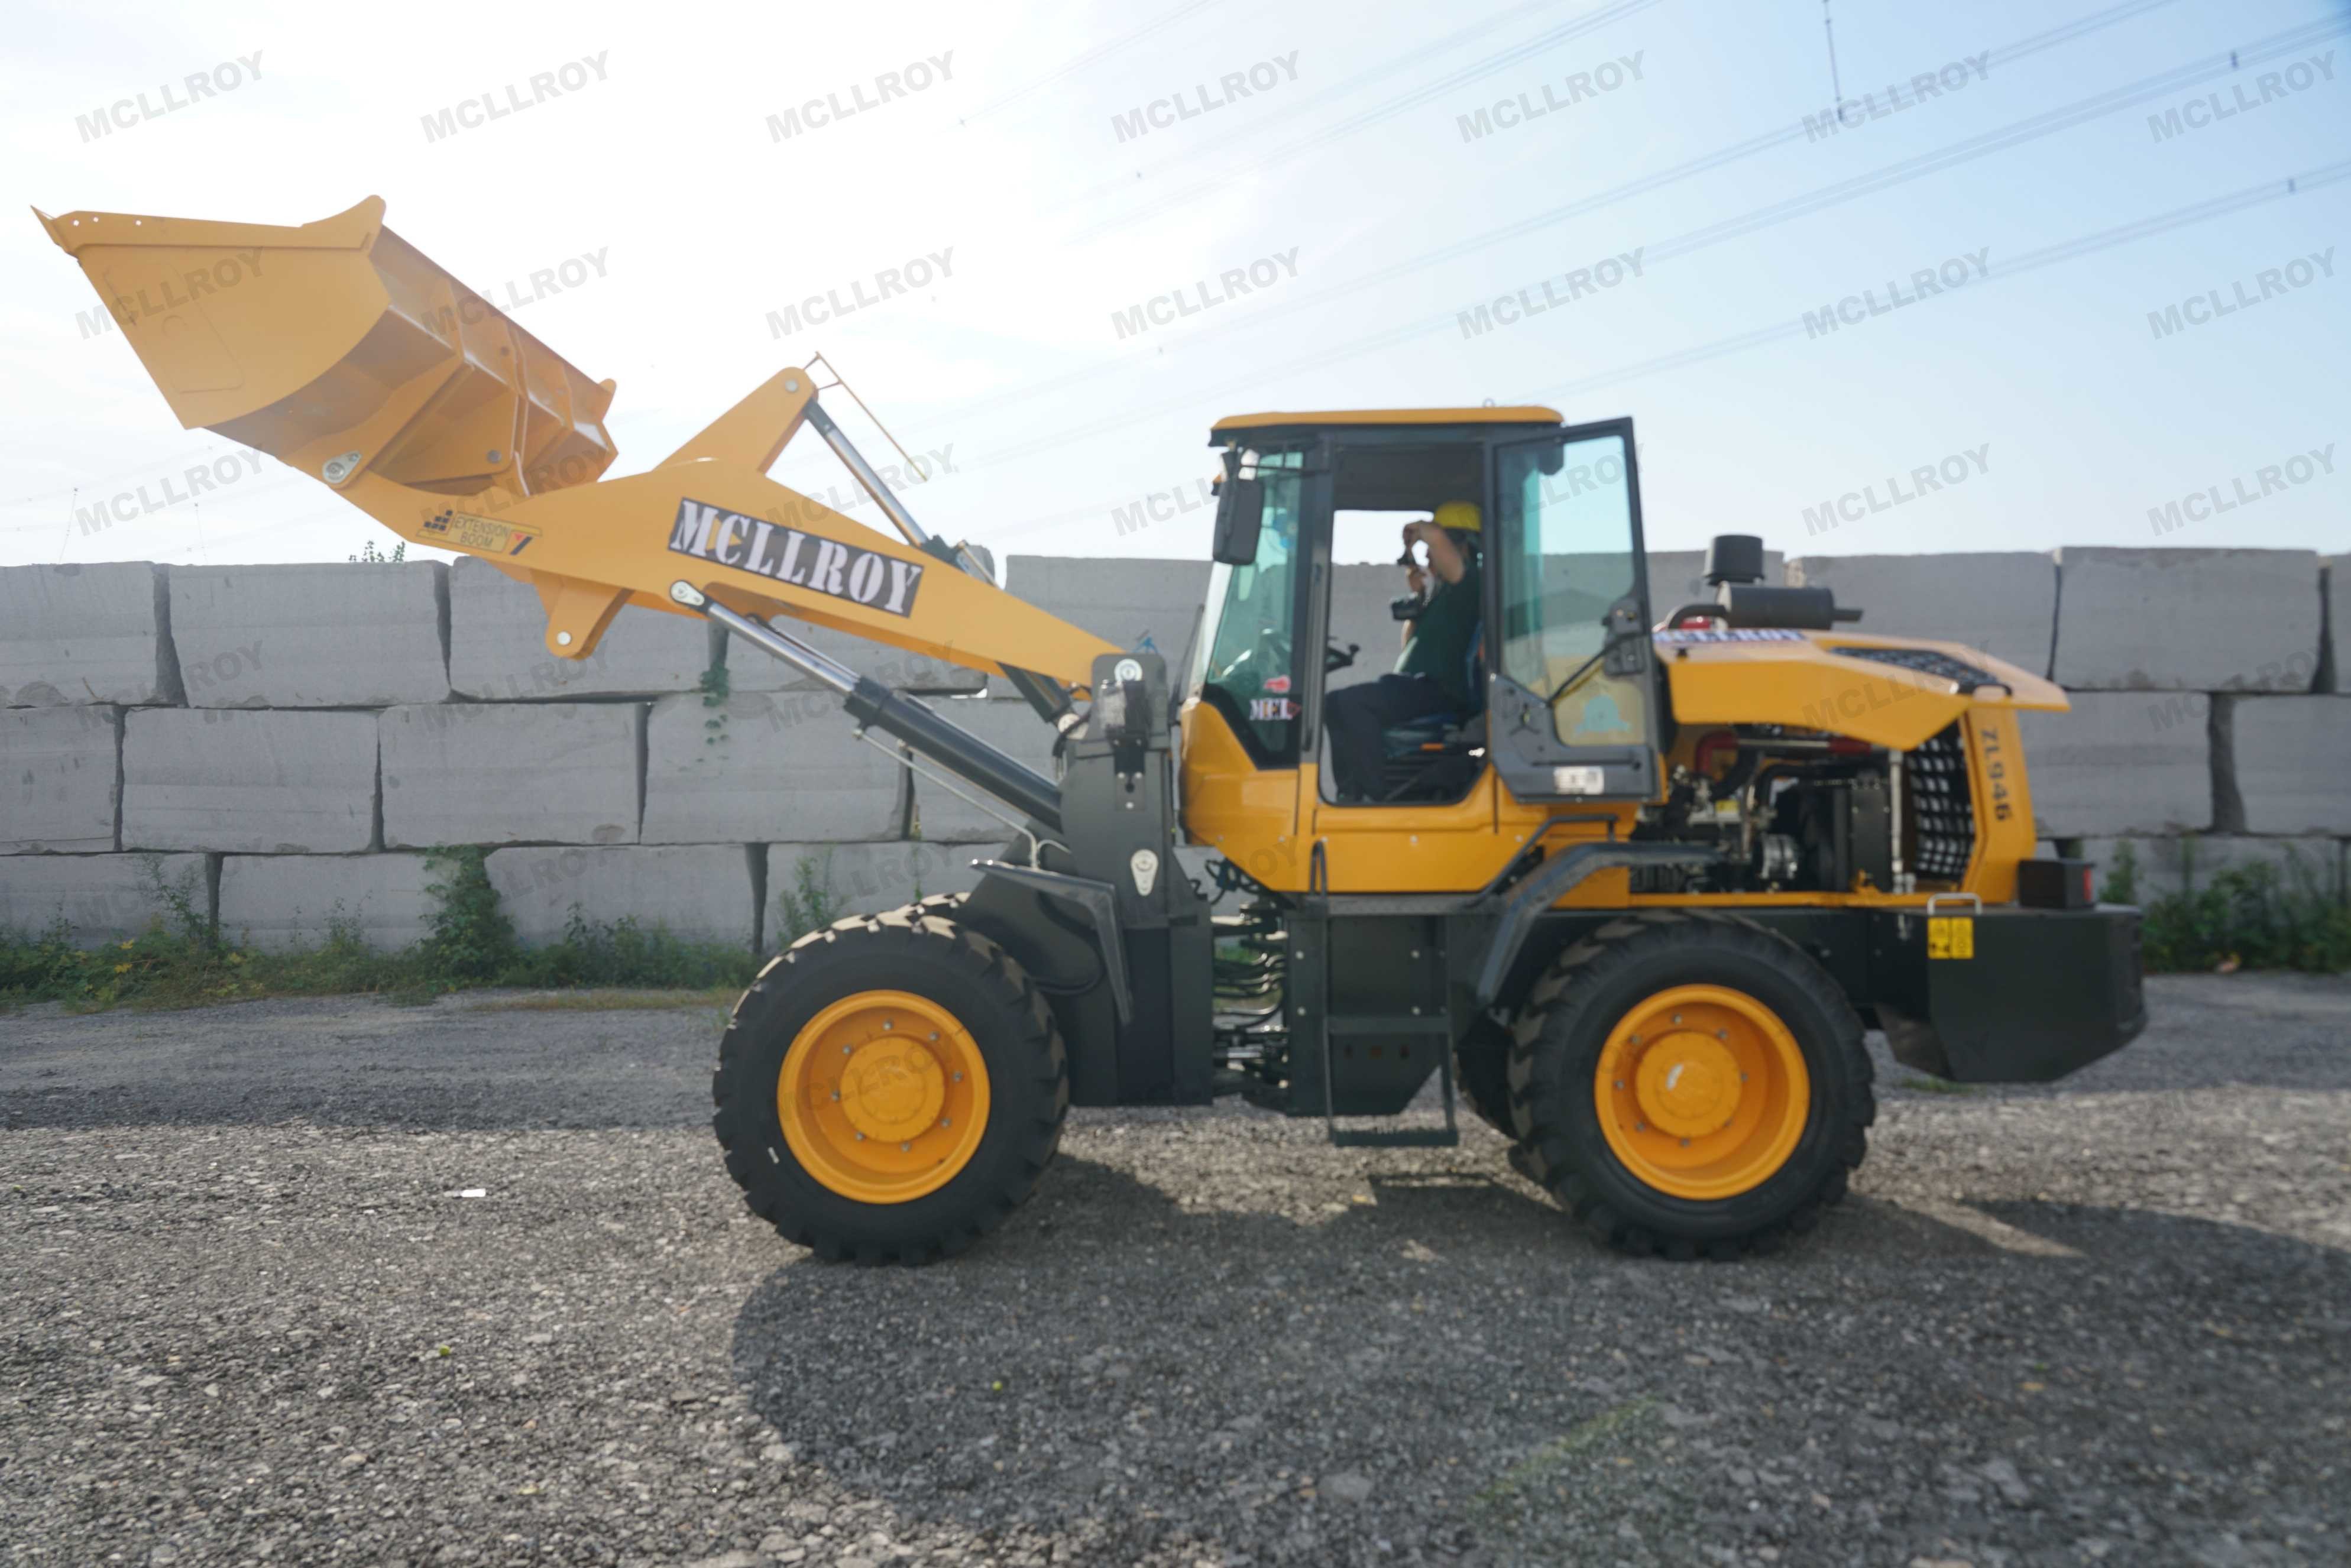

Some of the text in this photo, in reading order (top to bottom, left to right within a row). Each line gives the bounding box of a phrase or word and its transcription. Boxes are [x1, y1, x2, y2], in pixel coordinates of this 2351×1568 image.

[454, 516, 510, 537] EXTENSION
[461, 532, 493, 547] BOOM
[670, 500, 922, 613] MCLLROY
